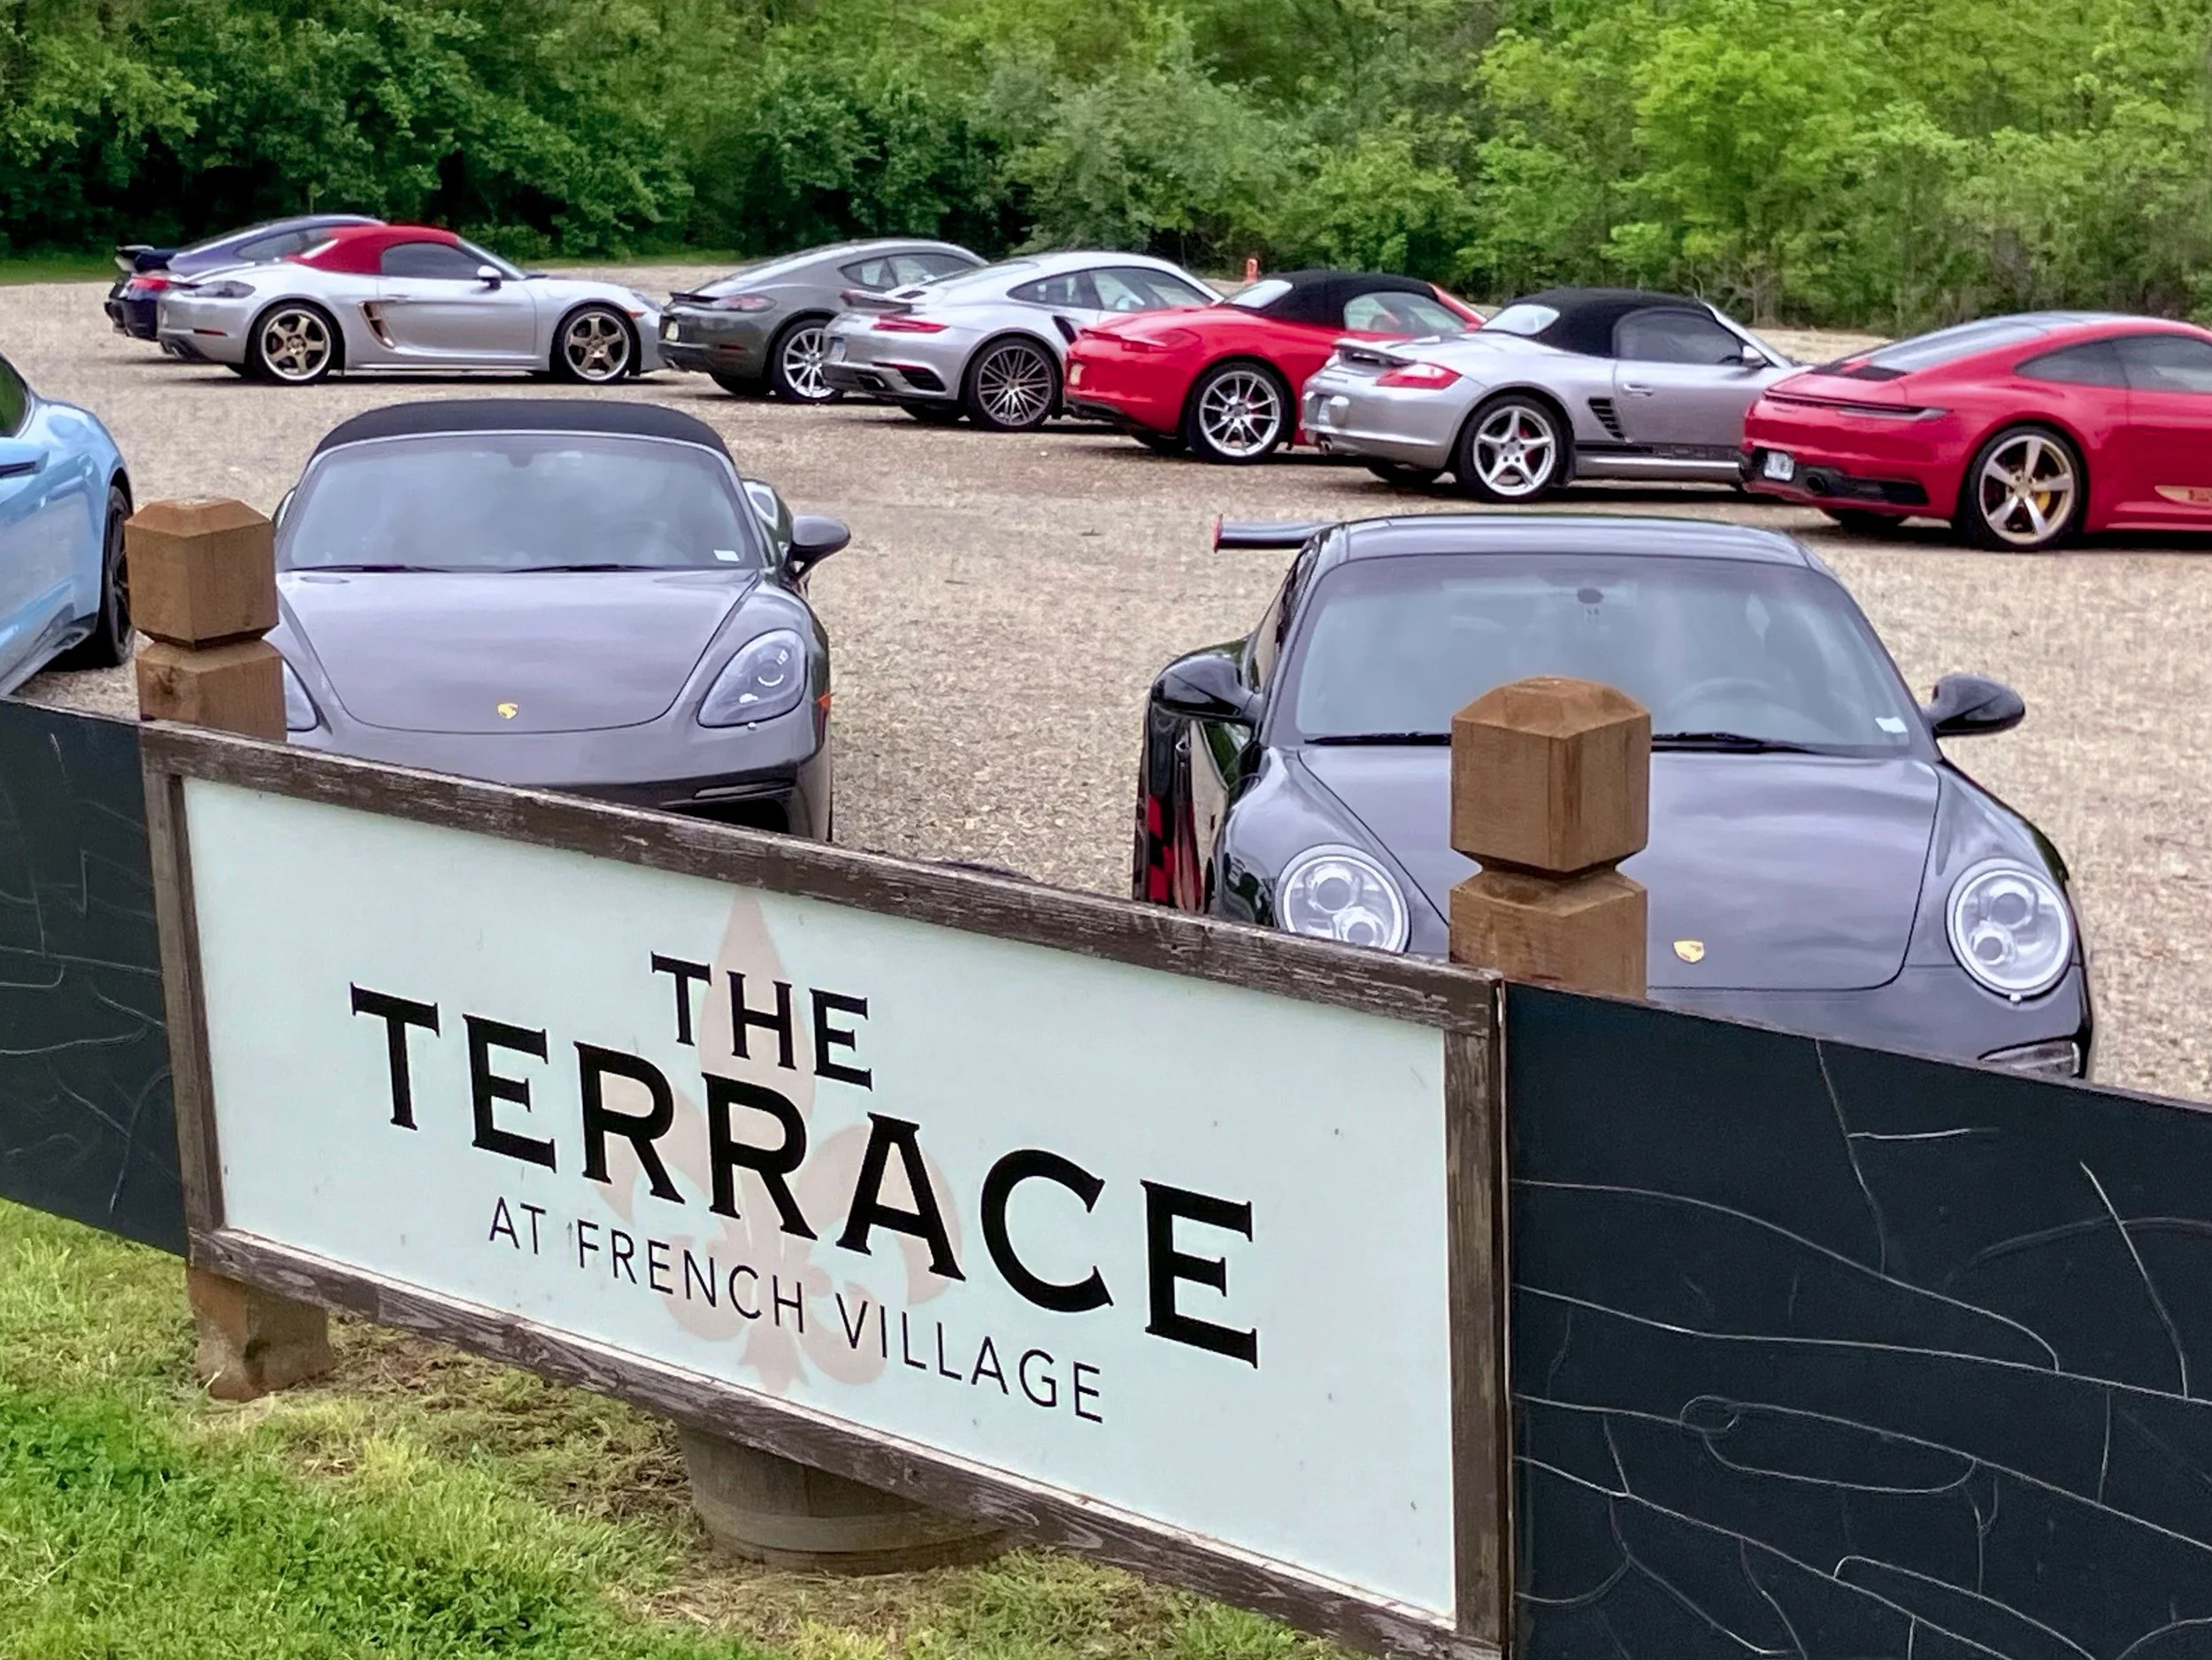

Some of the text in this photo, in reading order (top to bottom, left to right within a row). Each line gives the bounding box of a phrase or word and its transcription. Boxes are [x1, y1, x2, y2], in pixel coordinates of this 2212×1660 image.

[649, 950, 873, 1092] THE
[349, 981, 1258, 1370] TERRACE
[488, 1196, 1103, 1424] AT FRENCH VILLAGE
